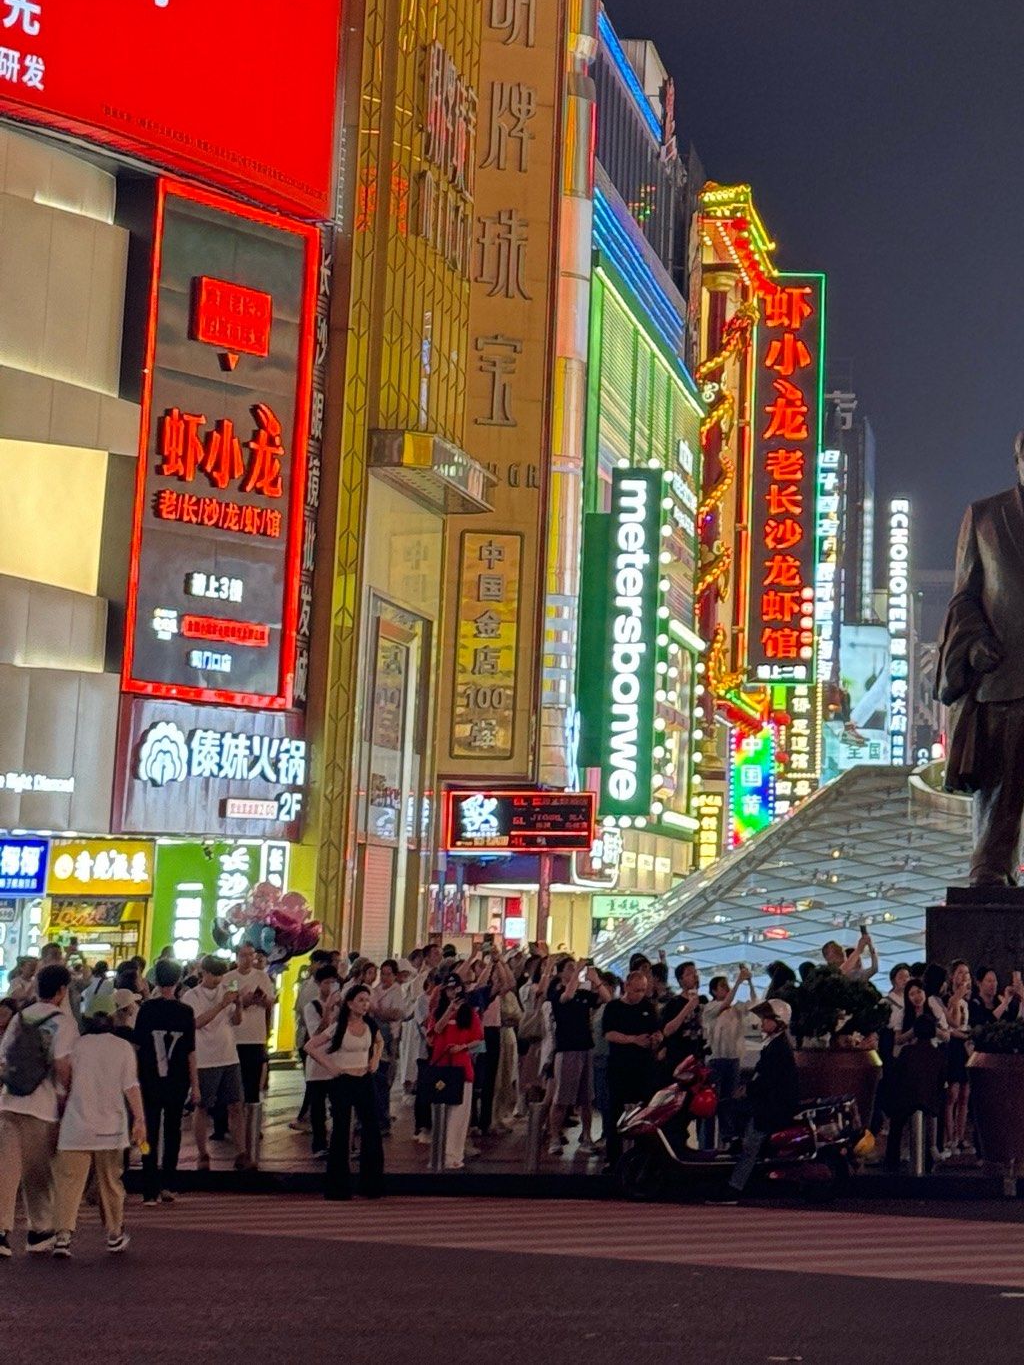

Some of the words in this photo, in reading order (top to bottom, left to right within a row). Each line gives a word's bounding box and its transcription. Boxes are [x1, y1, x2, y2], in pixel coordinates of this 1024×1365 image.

[0, 46, 46, 91] 研发
[763, 286, 813, 442] 虾小龙
[162, 403, 284, 498] 虾小龙
[760, 449, 805, 660] 老长沙龙虾馆
[888, 499, 910, 634] ECHOHOTEL
[606, 478, 651, 802] metersbonwe
[190, 728, 306, 786] 傣妹火锅
[278, 793, 302, 822] 2F
